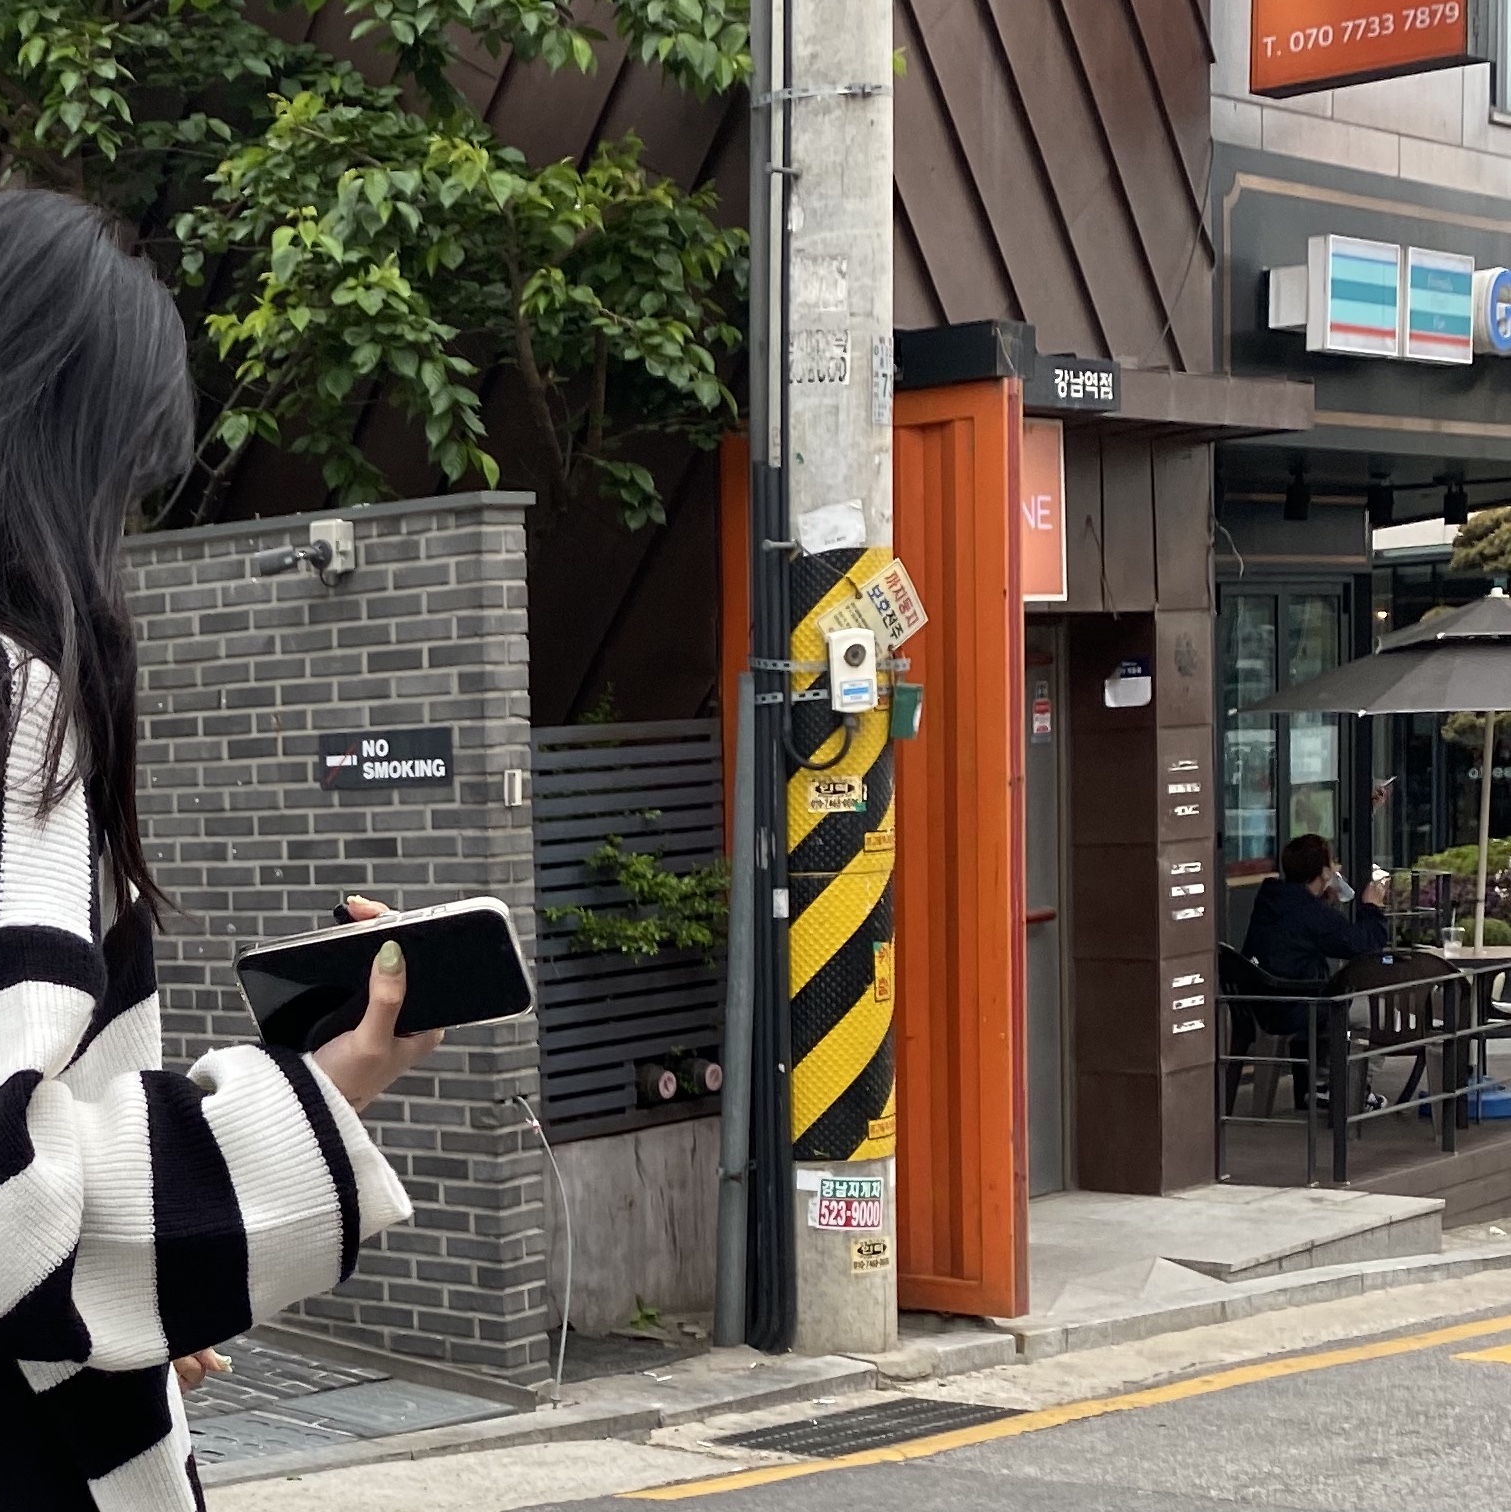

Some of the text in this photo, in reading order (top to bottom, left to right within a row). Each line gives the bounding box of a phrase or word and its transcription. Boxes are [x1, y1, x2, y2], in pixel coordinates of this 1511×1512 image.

[1262, 1, 1460, 58] T. 070 7733 7879
[1054, 368, 1114, 400] 강남역점
[866, 584, 904, 640] 보호전주
[362, 739, 389, 757] NO
[362, 758, 446, 780] SMOKING
[822, 1180, 881, 1198] 강남지게차
[820, 1200, 880, 1226] 523-9000
